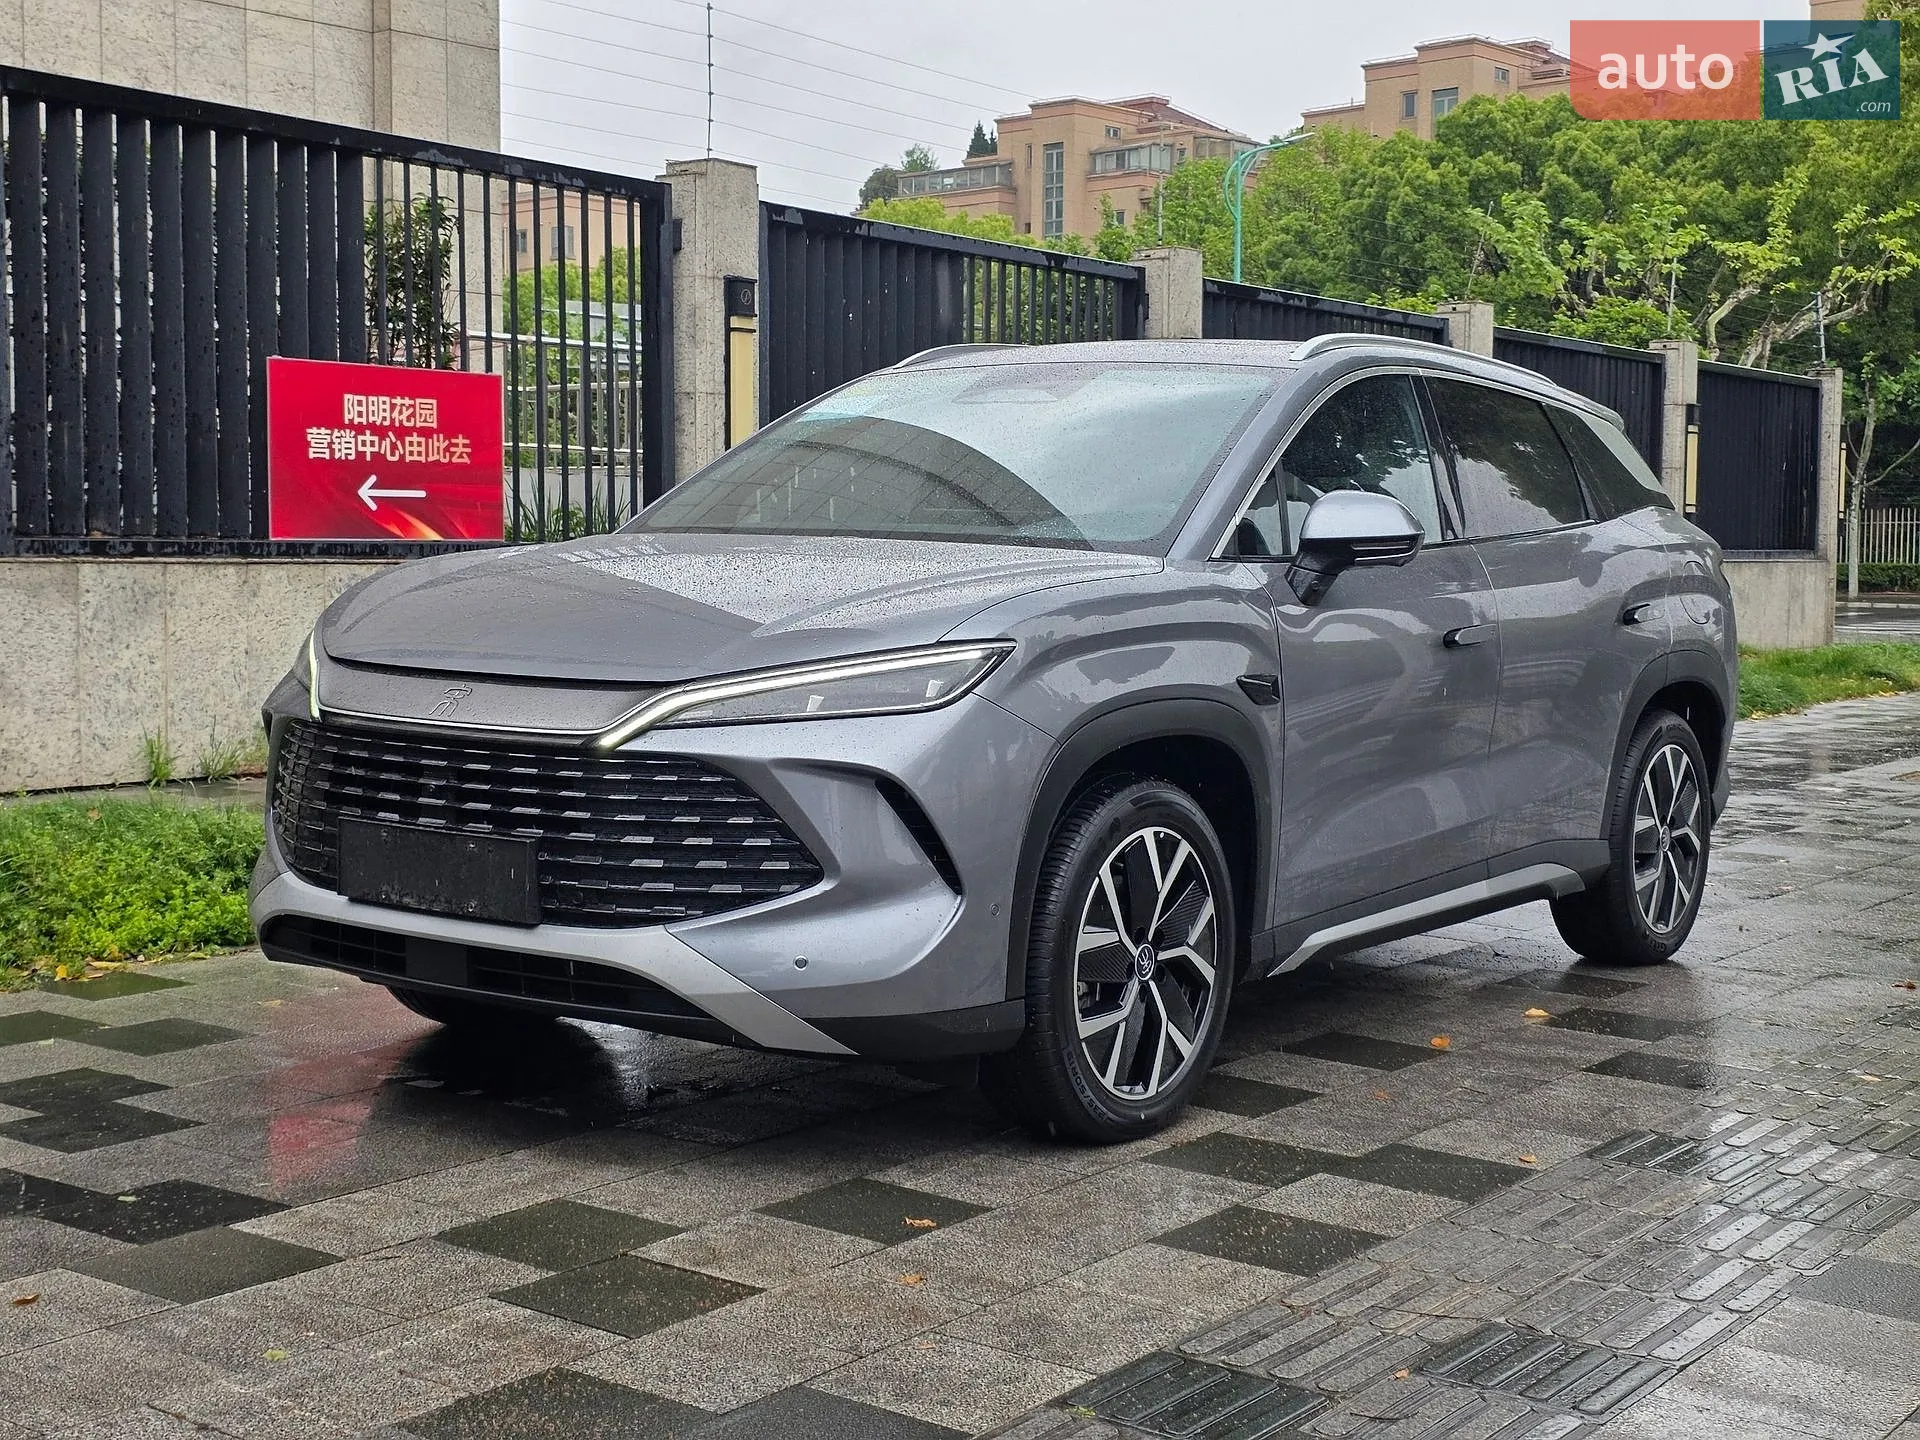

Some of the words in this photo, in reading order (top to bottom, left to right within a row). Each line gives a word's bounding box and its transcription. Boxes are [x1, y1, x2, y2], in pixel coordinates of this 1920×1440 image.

[343, 393, 438, 429] 阳明花园
[306, 426, 472, 465] 营销中心由此去
